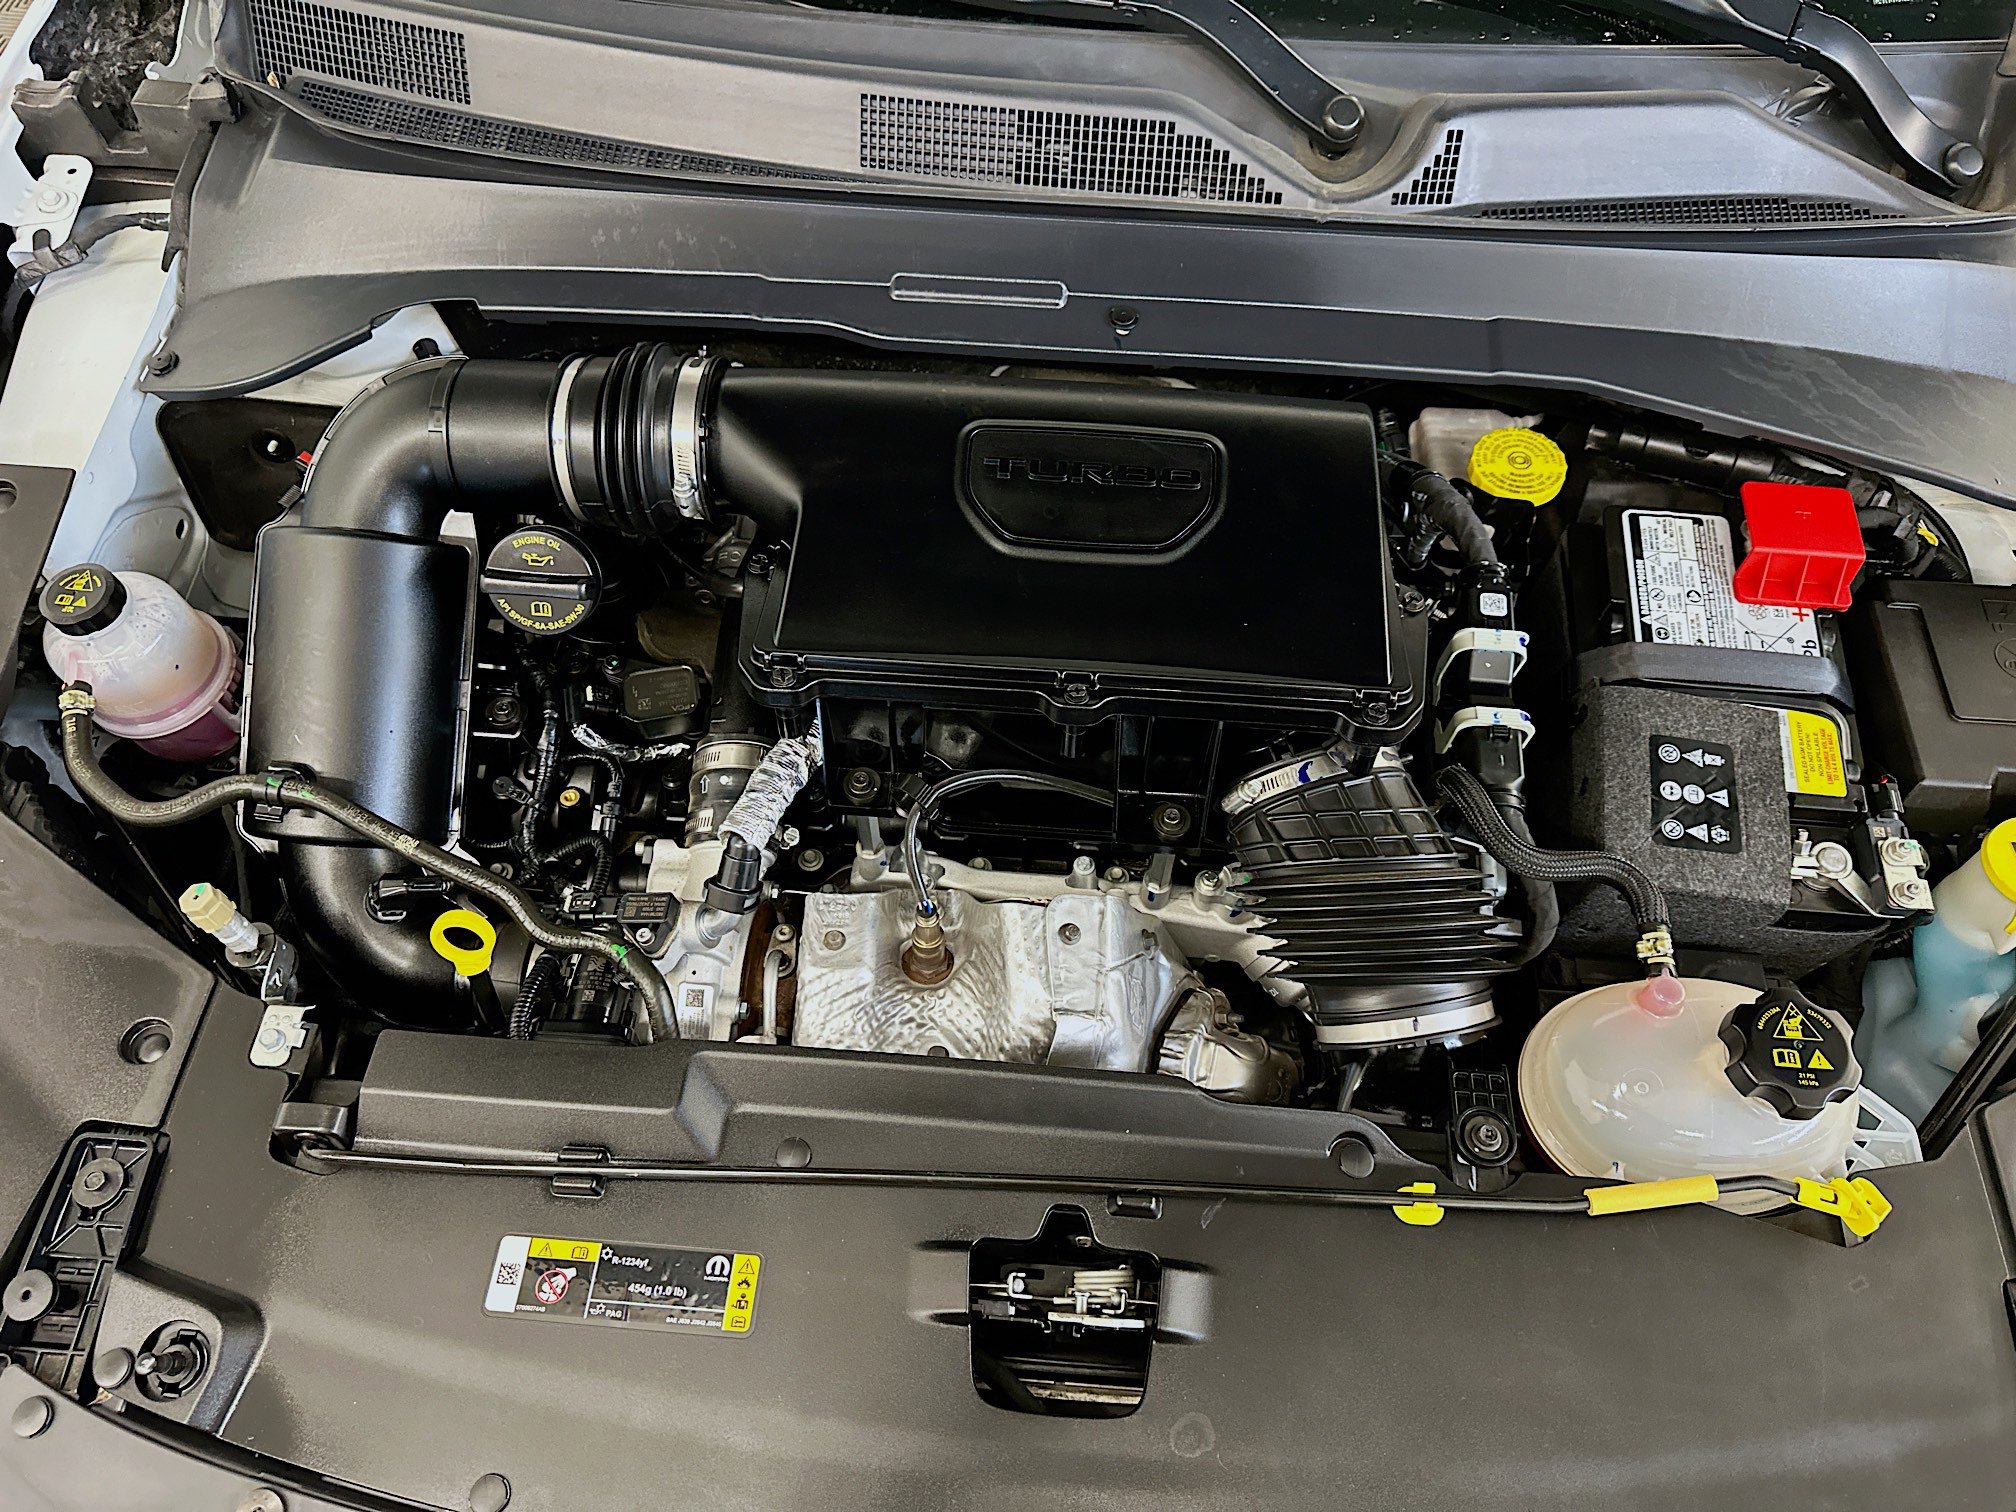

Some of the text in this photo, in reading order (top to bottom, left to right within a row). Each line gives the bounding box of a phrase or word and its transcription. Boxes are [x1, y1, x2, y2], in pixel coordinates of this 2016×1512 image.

[984, 457, 1201, 490] TURBO
[512, 536, 561, 551] ENGINE OIL
[1636, 560, 1650, 615] DANGER/POISON
[497, 598, 511, 612] API
[1819, 728, 1828, 749] VOLTAGE
[1801, 761, 1810, 782] SEALED
[1825, 772, 1833, 784] LIMIT
[611, 1256, 650, 1268] R-1234yf
[627, 1283, 688, 1299] 454g (1.0 lb)
[605, 1309, 622, 1319] PAG
